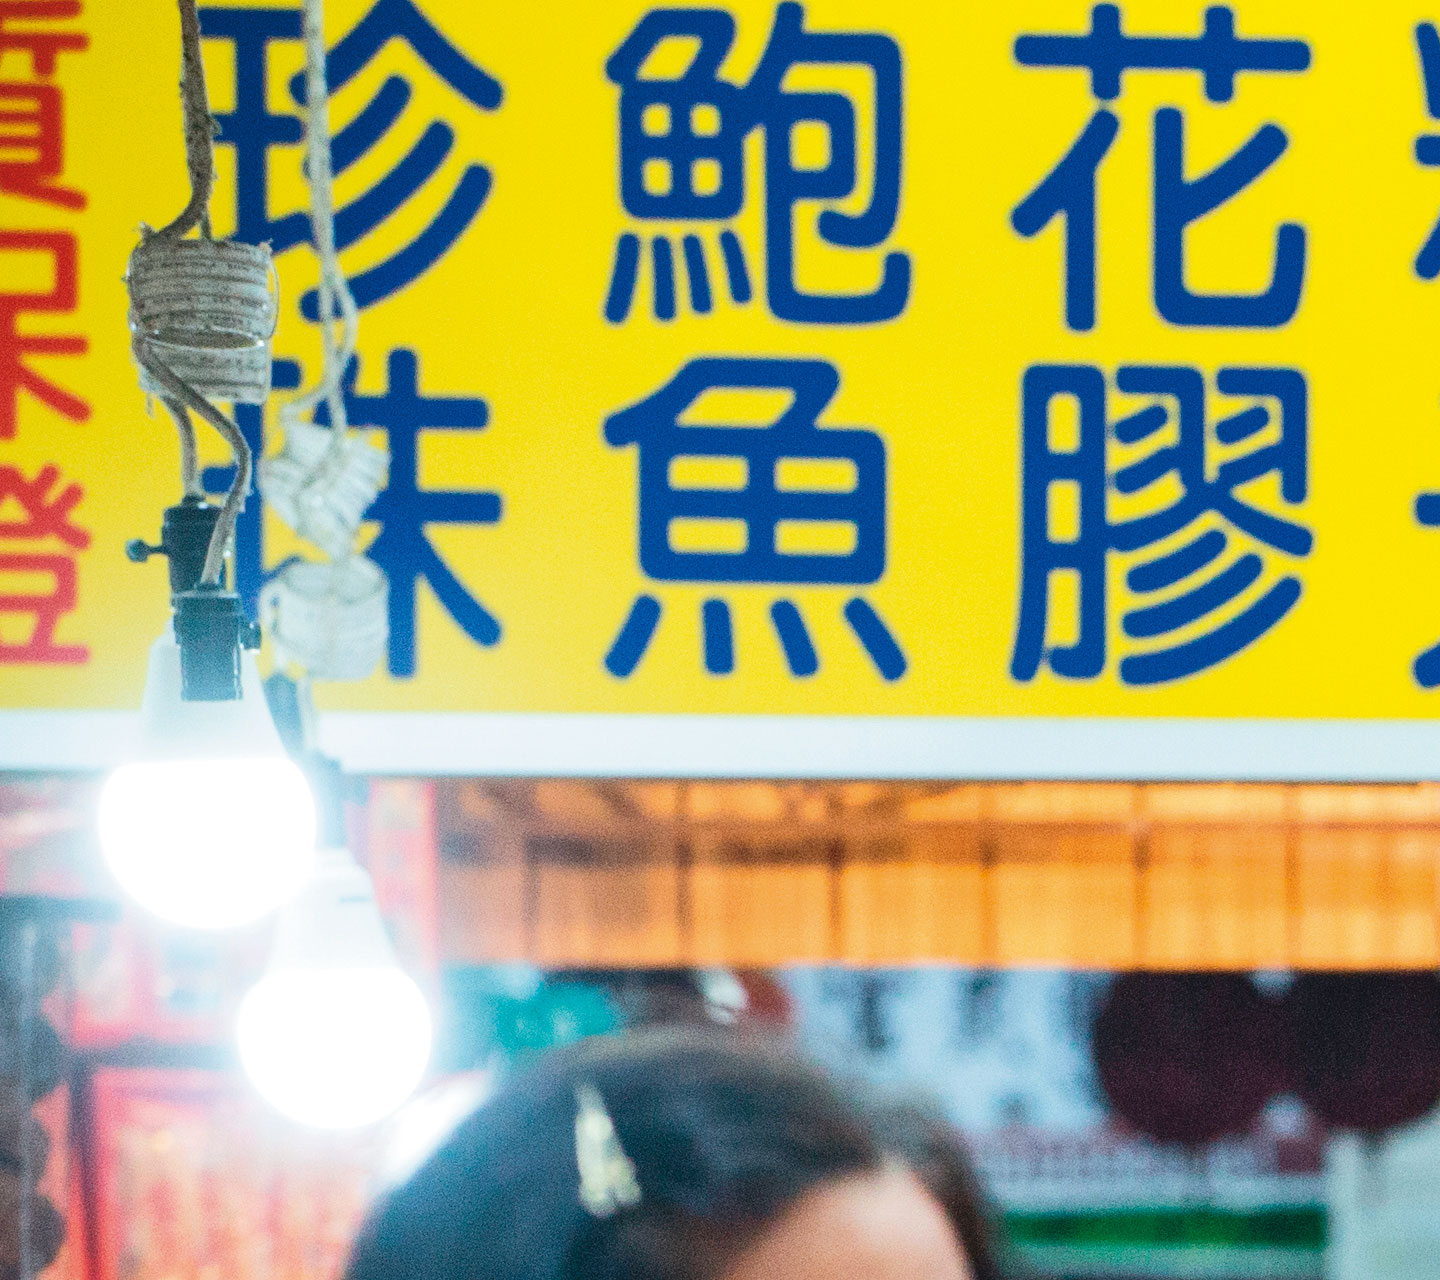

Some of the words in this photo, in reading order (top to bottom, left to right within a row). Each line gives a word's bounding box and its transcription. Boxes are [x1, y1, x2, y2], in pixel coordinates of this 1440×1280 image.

[197, 0, 502, 684] 珍珠
[604, 2, 911, 682] 鮑魚
[1011, 4, 1313, 686] 花膠
